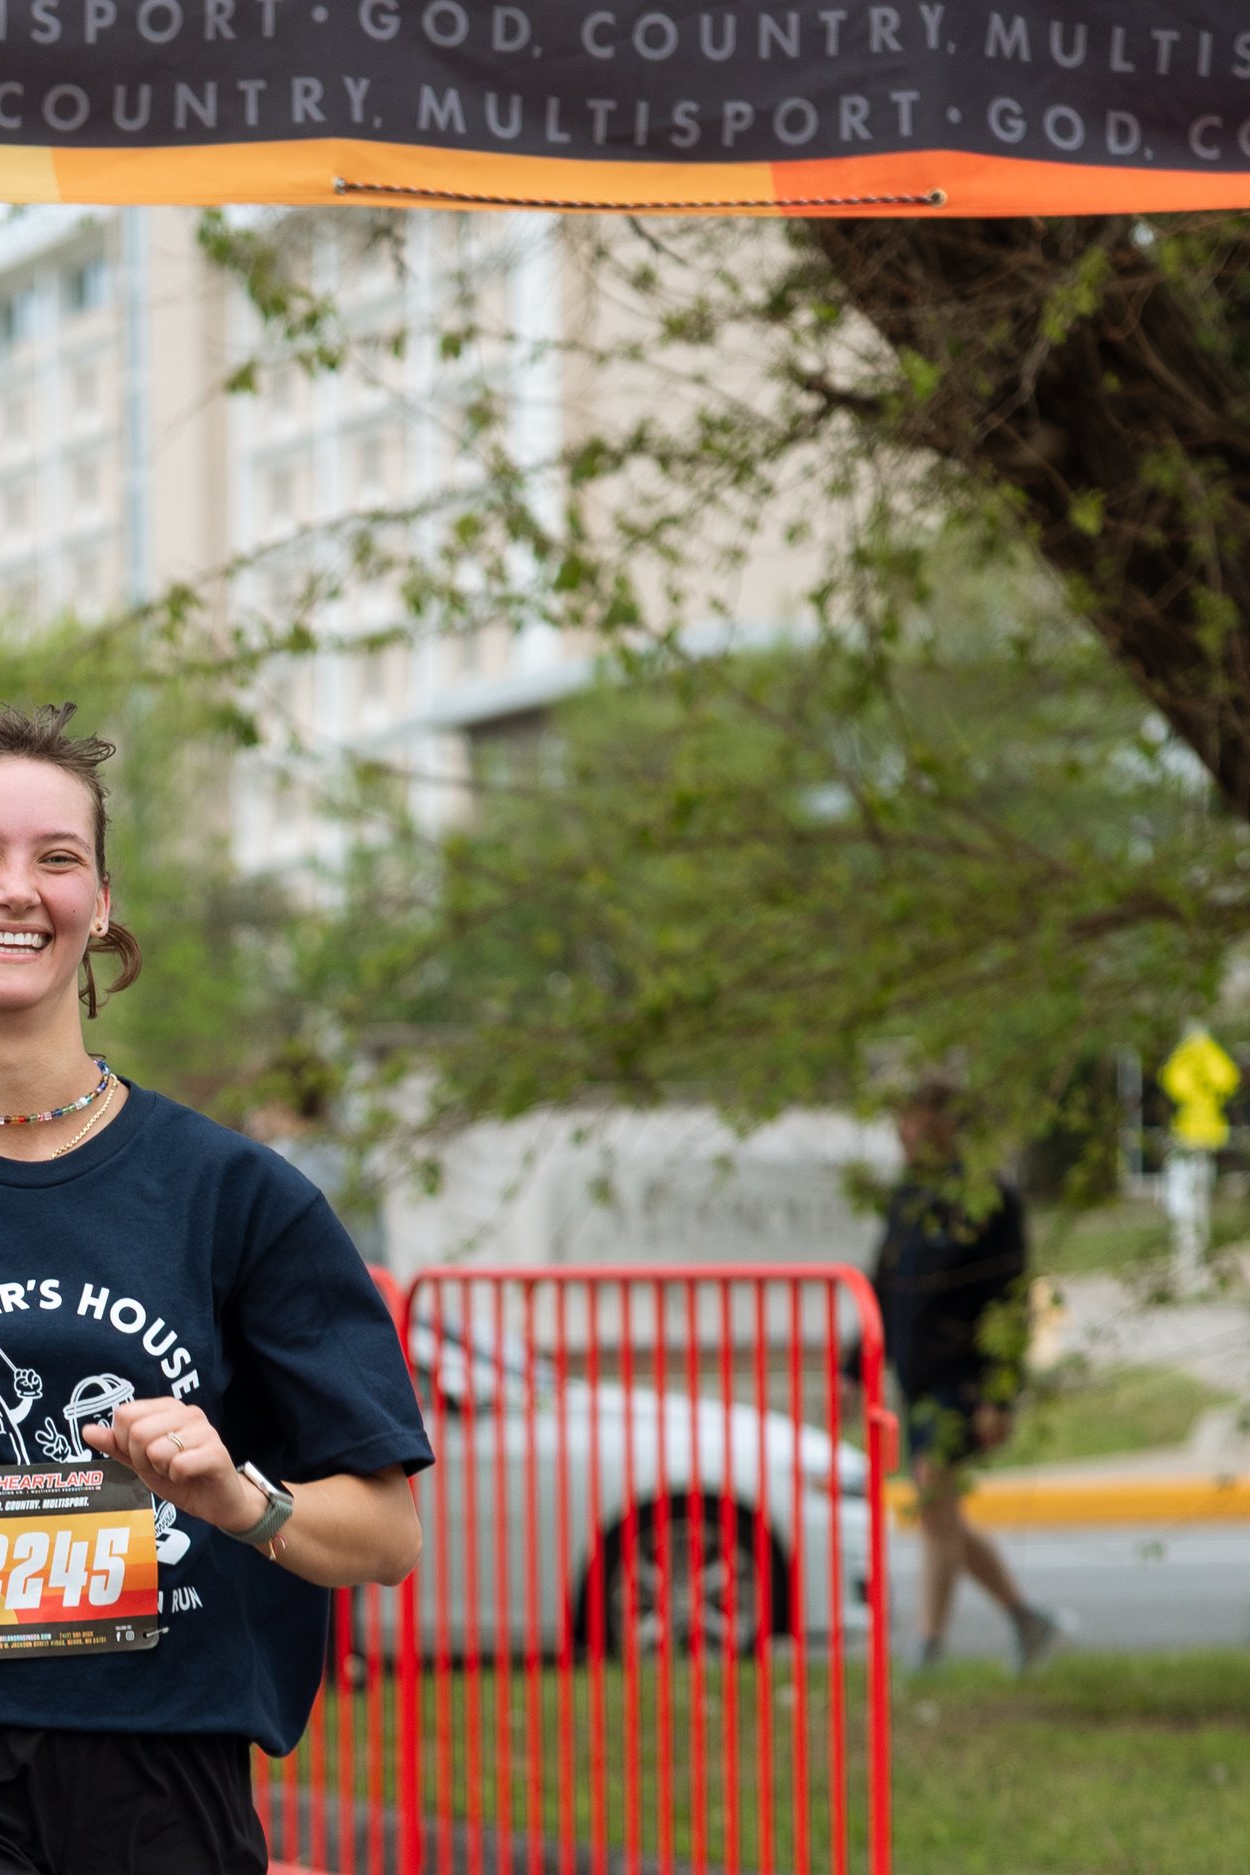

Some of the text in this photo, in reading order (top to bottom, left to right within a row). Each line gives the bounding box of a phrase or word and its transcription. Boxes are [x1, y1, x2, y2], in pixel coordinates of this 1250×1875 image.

[356, 0, 543, 58] GOD,
[580, 3, 956, 62] COUNTRY,
[417, 83, 921, 147] MULTISPORT
[987, 97, 1154, 161] GOD,
[76, 1282, 200, 1400] HOUSE
[5, 1499, 41, 1511] COUNTRY.
[42, 1496, 90, 1509] MULTISPORT.
[171, 1586, 204, 1614] RUN
